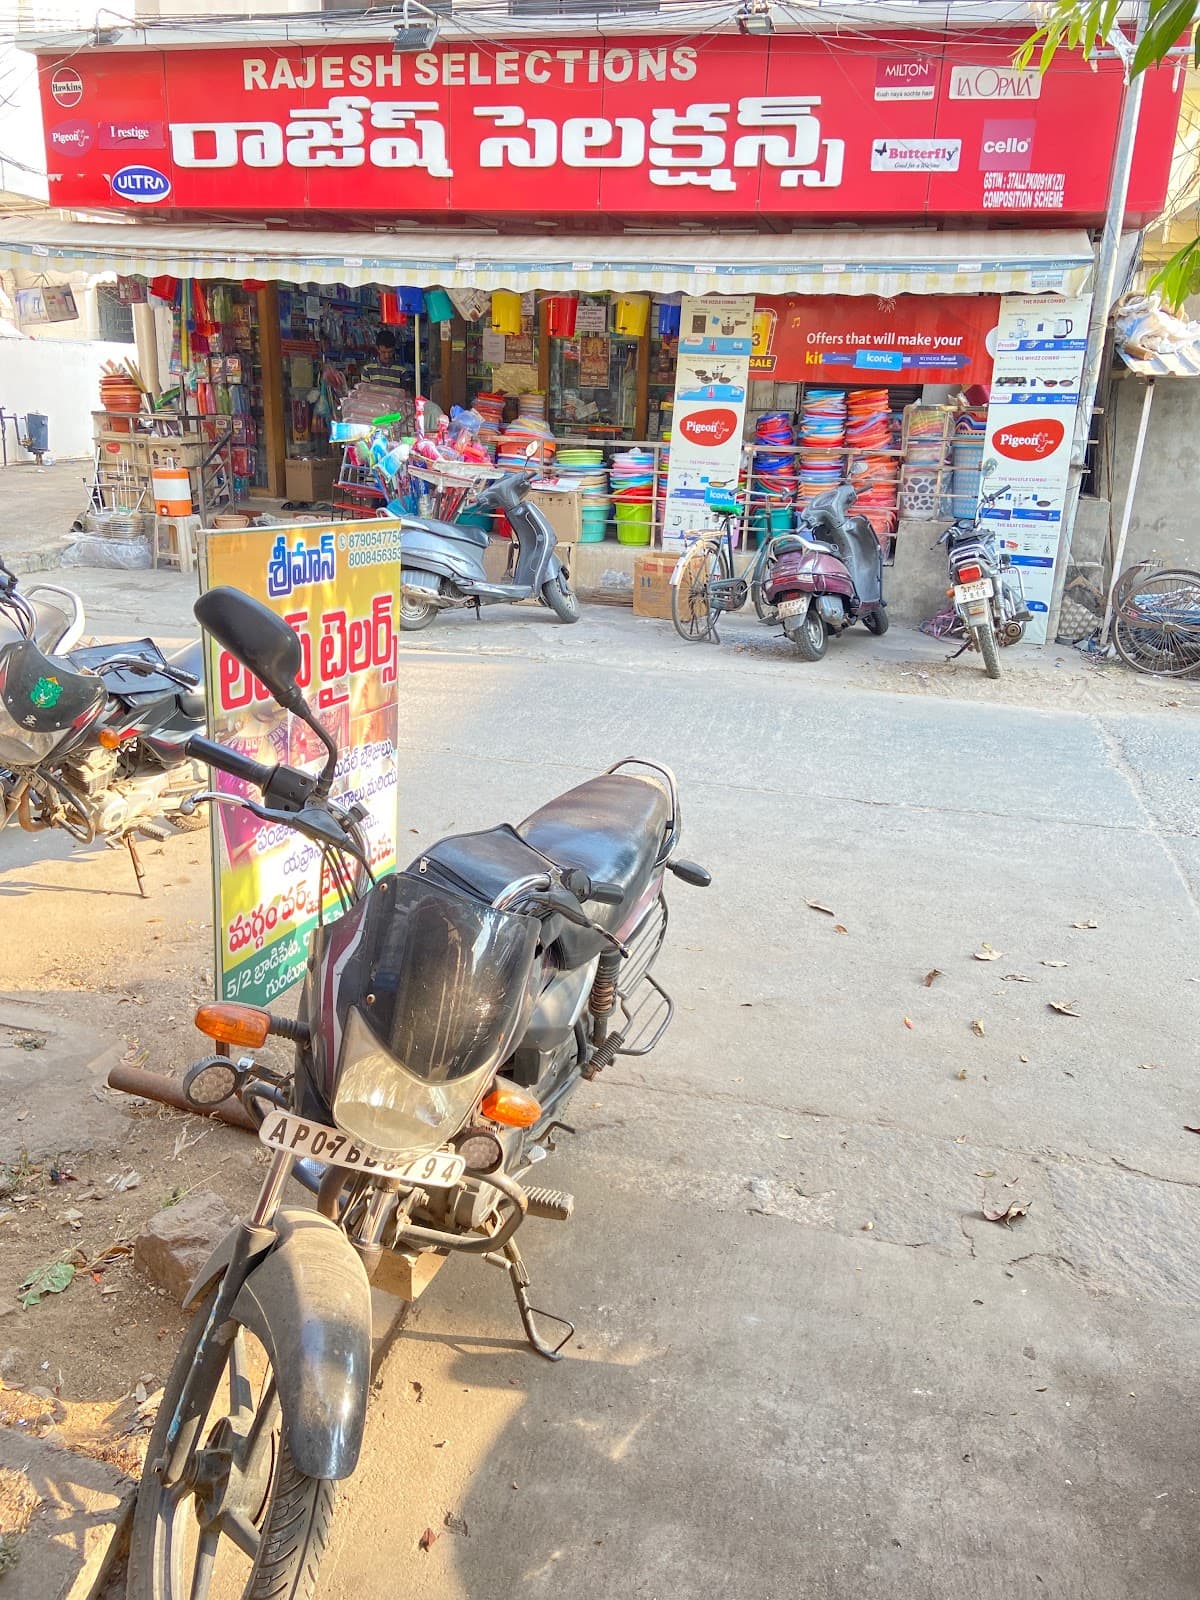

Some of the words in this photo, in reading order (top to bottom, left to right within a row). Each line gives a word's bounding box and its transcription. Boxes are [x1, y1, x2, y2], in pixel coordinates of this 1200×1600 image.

[243, 54, 401, 90] RAJESH
[415, 46, 697, 86] SELECTIONS
[885, 63, 929, 77] MILTON
[52, 82, 82, 92] Hawkins
[52, 132, 79, 144] Pigeon
[168, 95, 453, 178] రాజేష్
[473, 95, 844, 192] సెలక్షన్స్
[983, 138, 1029, 153] cello
[888, 148, 955, 161] Butterfly
[117, 174, 164, 190] ULTRA
[983, 190, 1033, 208] COMPOSITION
[1034, 190, 1065, 208] SCHEME
[806, 331, 844, 345] Offers
[846, 333, 871, 345] that
[873, 332, 895, 345] will
[897, 333, 932, 346] make
[933, 335, 963, 349] your
[749, 359, 772, 368] SALE
[685, 420, 717, 434] Pigeon
[1000, 433, 1039, 448] Pigeon
[227, 968, 252, 999] 5/2
